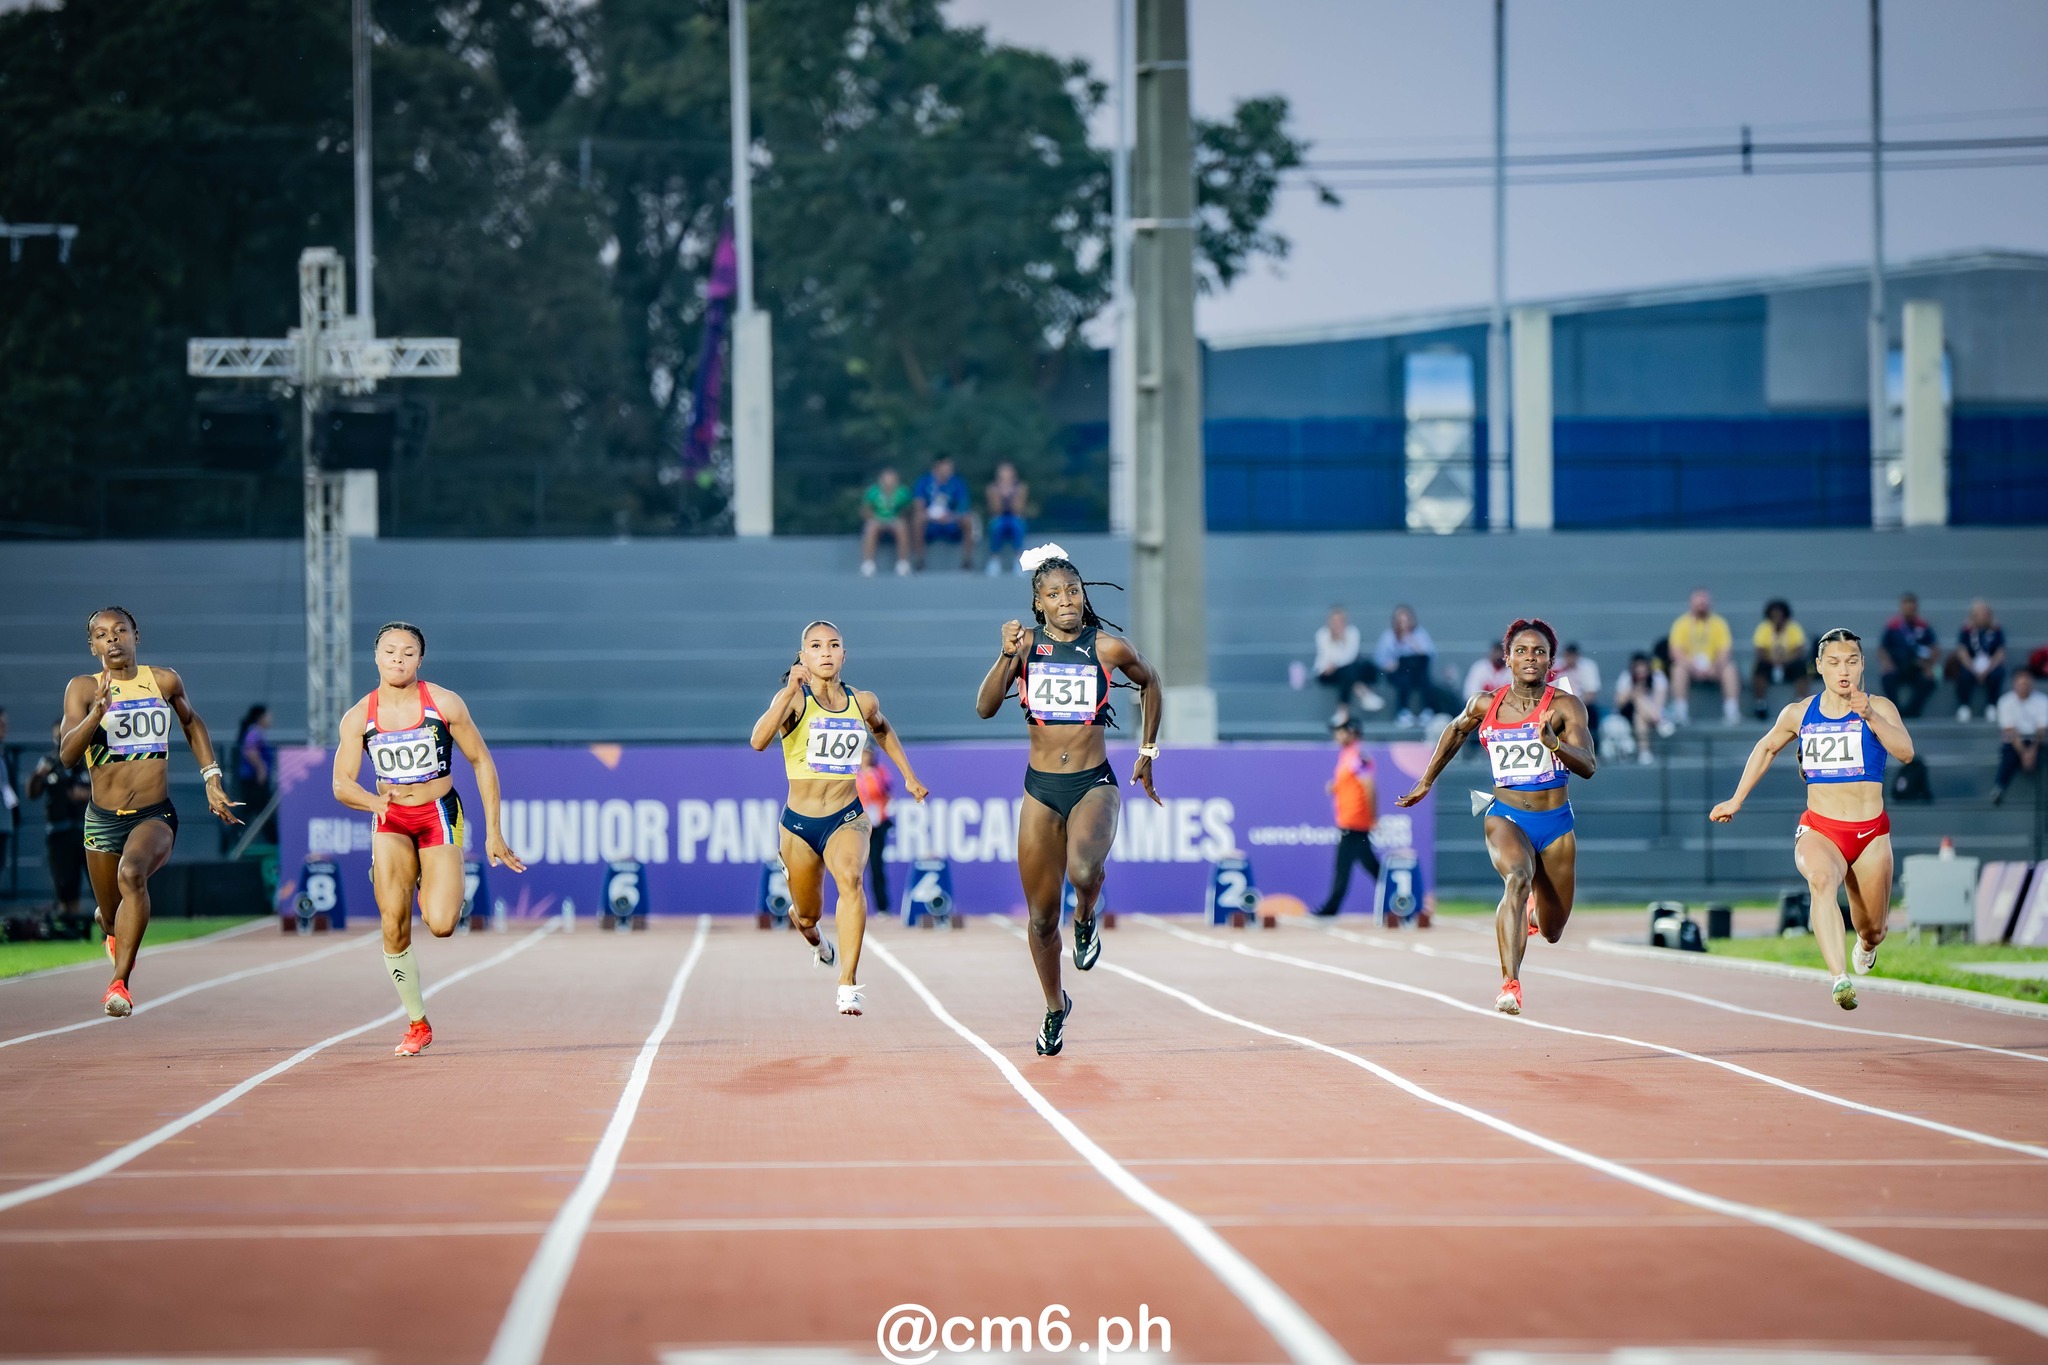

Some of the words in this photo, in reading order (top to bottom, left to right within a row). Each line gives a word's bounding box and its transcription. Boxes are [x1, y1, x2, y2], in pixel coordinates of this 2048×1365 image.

[1034, 678, 1090, 706] 431
[114, 710, 166, 739] 300
[377, 743, 432, 772] 002
[815, 732, 860, 760] 169
[1495, 742, 1545, 771] 229
[1805, 735, 1854, 763] 421
[676, 798, 779, 864] PAN
[1107, 797, 1236, 864] AMES
[306, 874, 337, 911] 8
[608, 872, 640, 909] 6
[1217, 870, 1248, 908] 2
